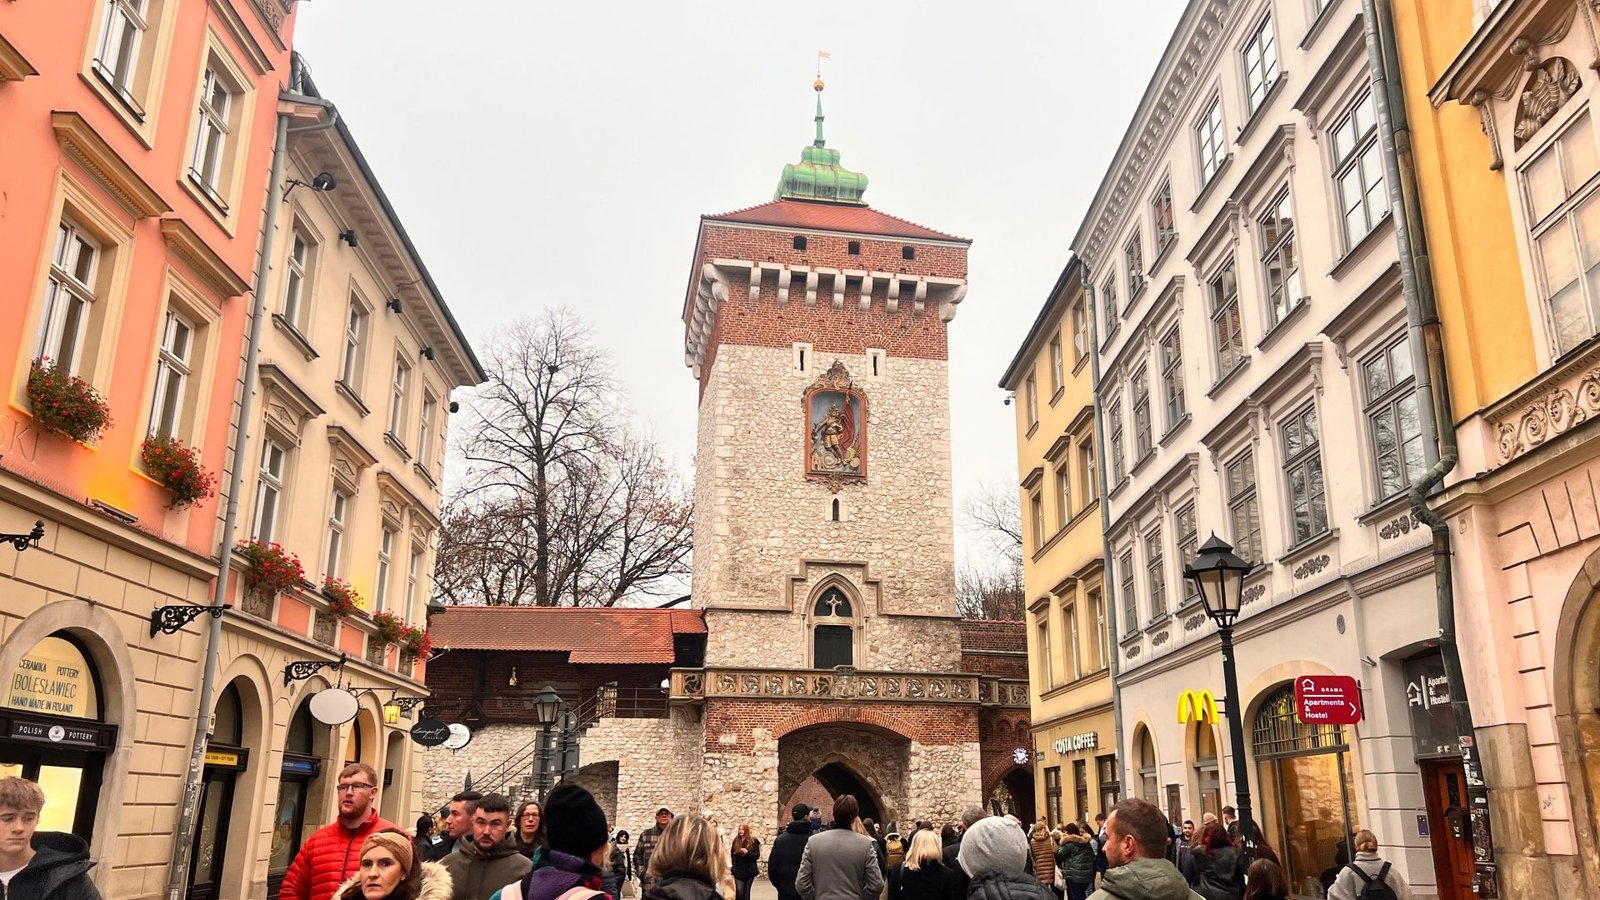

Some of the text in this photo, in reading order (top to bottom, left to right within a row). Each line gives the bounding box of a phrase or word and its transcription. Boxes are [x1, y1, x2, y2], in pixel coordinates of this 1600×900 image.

[19, 659, 80, 679] CERAMIKA POTTERY
[11, 695, 73, 713] HAND MADE IN POLAND
[1304, 699, 1345, 707] Apartments
[19, 725, 43, 735] POLISH
[68, 731, 93, 741] POTTERY
[1055, 732, 1095, 754] COSTA COFFEE
